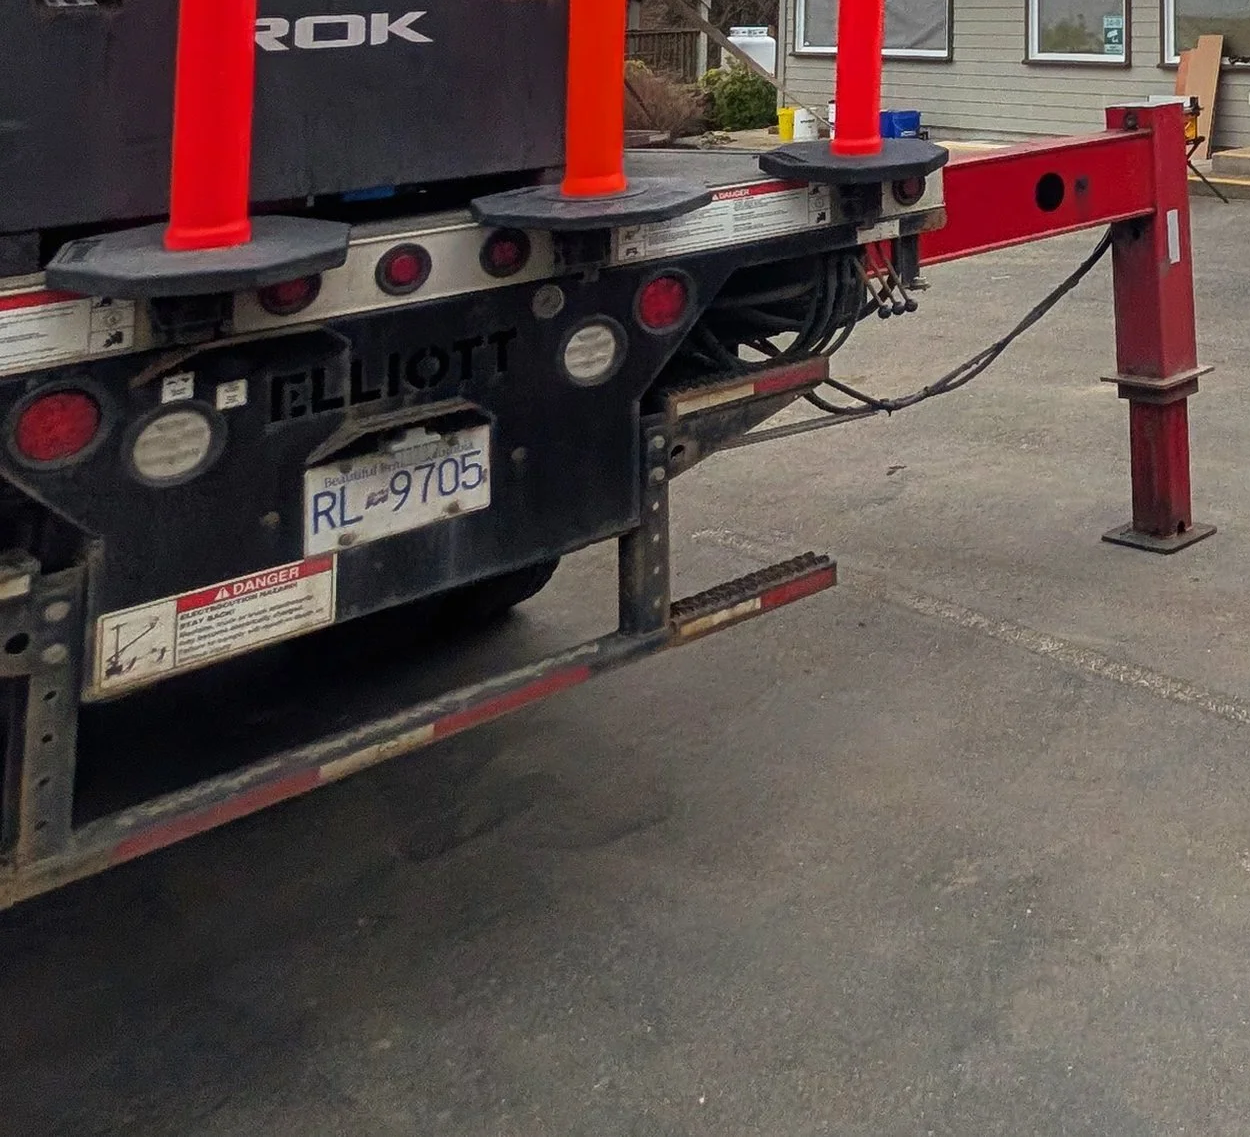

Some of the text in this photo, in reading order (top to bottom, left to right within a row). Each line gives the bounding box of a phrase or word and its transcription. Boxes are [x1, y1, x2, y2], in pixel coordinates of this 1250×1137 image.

[271, 327, 517, 423] ELLIOTT
[313, 450, 482, 534] RL 9705
[233, 567, 300, 595] DANGER
